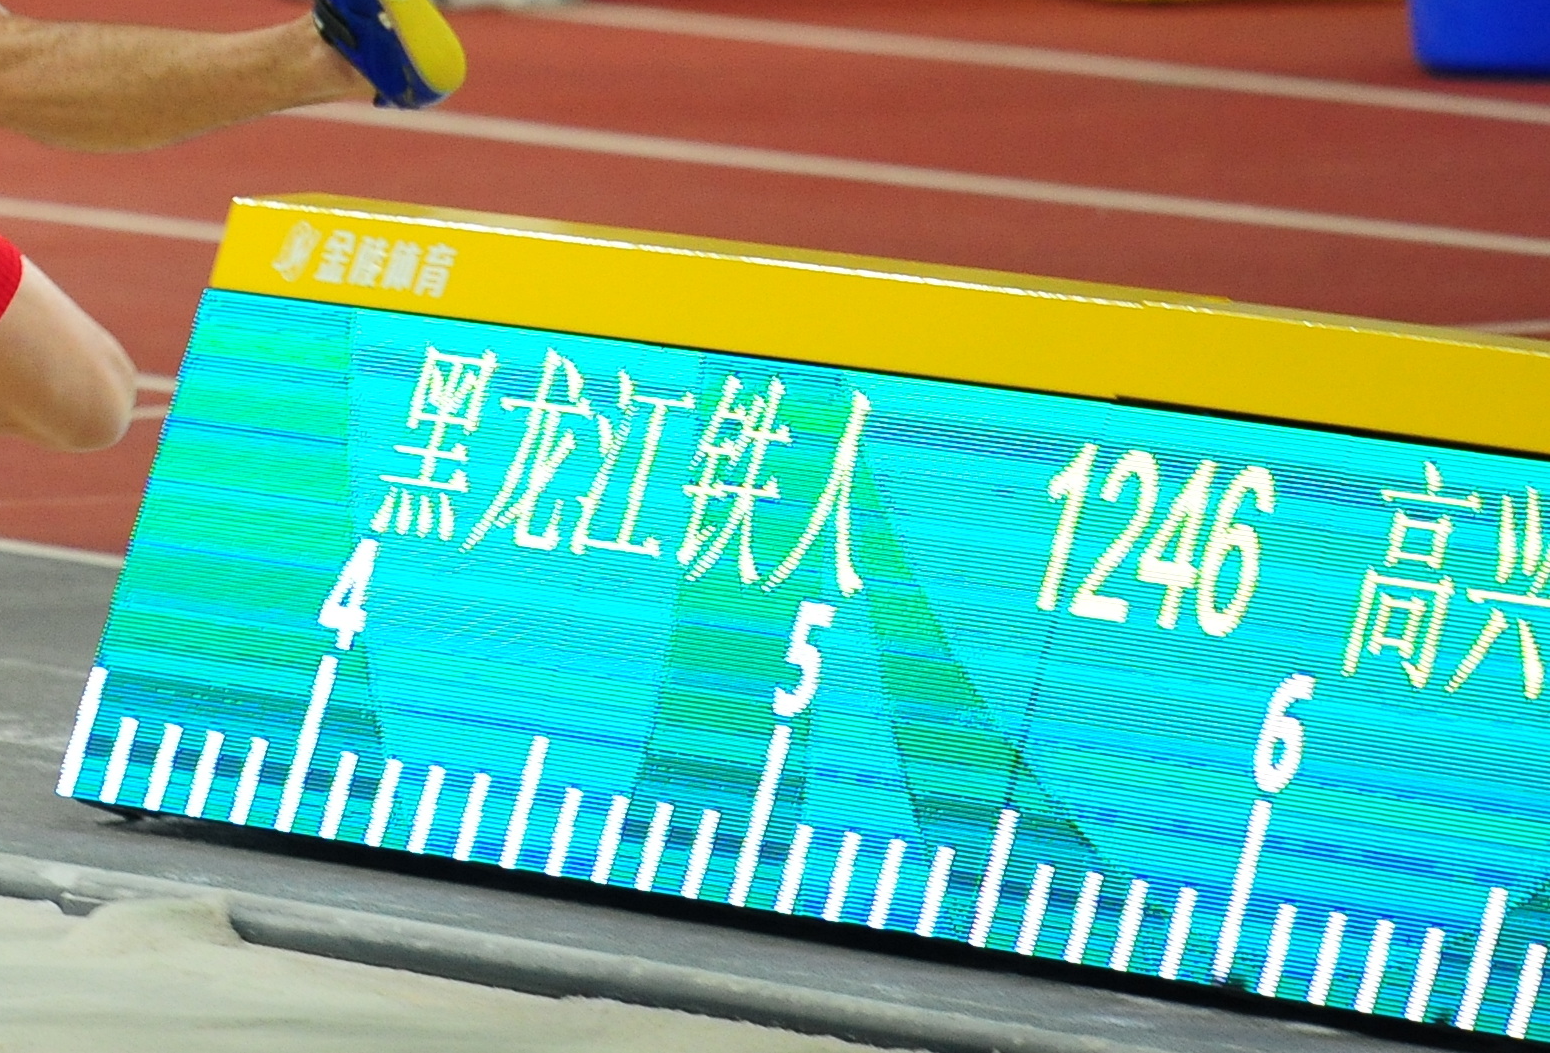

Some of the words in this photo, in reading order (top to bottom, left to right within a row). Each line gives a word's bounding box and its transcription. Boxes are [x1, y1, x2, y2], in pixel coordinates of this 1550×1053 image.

[318, 537, 379, 651] 4
[772, 600, 838, 718] 5
[1252, 671, 1317, 794] 6
[370, 344, 871, 597] 黑龙江铁人
[1035, 442, 1276, 637] 1246
[1341, 460, 1550, 701] 高兴
